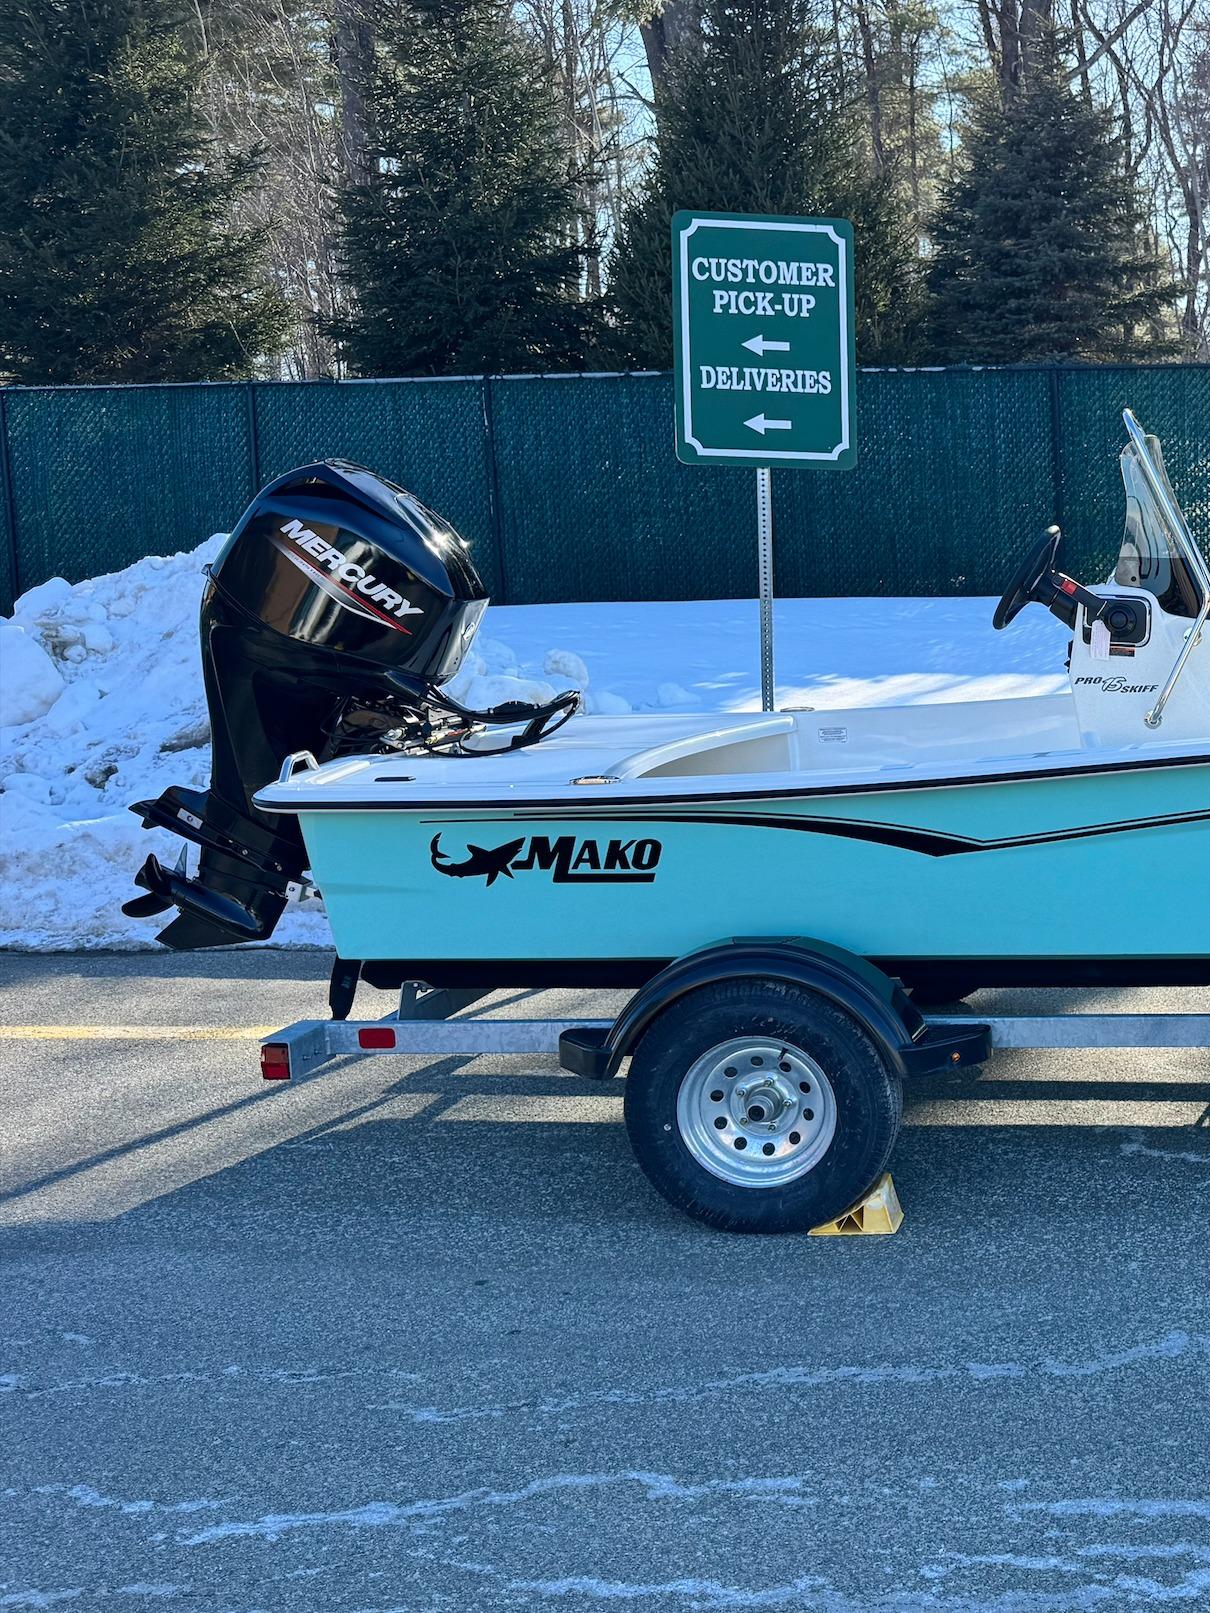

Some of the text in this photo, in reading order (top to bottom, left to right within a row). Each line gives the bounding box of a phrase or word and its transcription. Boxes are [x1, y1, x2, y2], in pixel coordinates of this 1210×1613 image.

[691, 257, 836, 287] CUSTOMER
[713, 290, 816, 317] PICK-UP
[700, 365, 832, 394] DELIVERIES
[279, 518, 425, 618] MERCURY
[1074, 676, 1103, 685] PRO
[1120, 684, 1159, 693] SKIFF
[510, 836, 662, 883] MAKO
